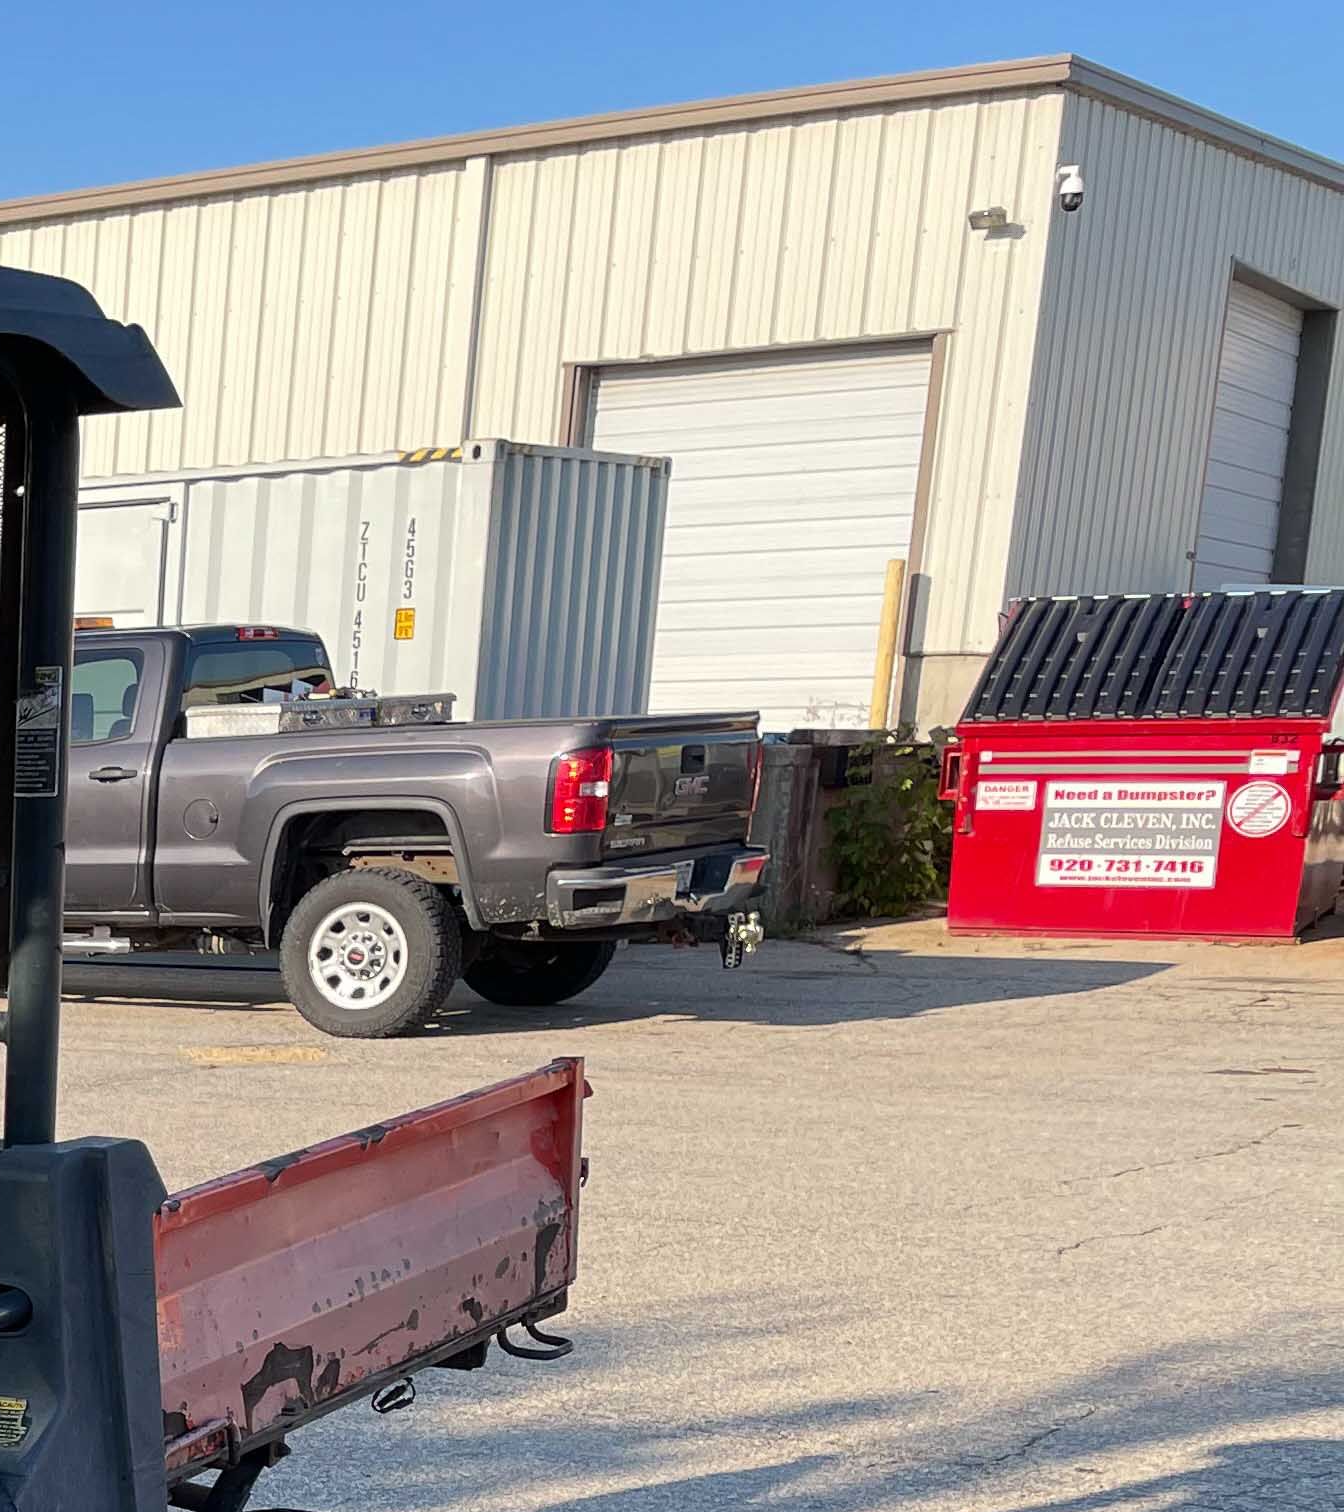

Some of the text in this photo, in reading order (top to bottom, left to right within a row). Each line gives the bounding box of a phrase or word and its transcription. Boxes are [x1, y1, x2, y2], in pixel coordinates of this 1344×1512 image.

[356, 521, 371, 602] ZTCU
[403, 517, 417, 600] 45G3
[984, 785, 1029, 793] DANGER
[1054, 789, 1217, 802] Need a Dumpster?
[1048, 812, 1217, 832] JACK CLEVEN, INC.
[1046, 833, 1213, 850] Refuse Services Division
